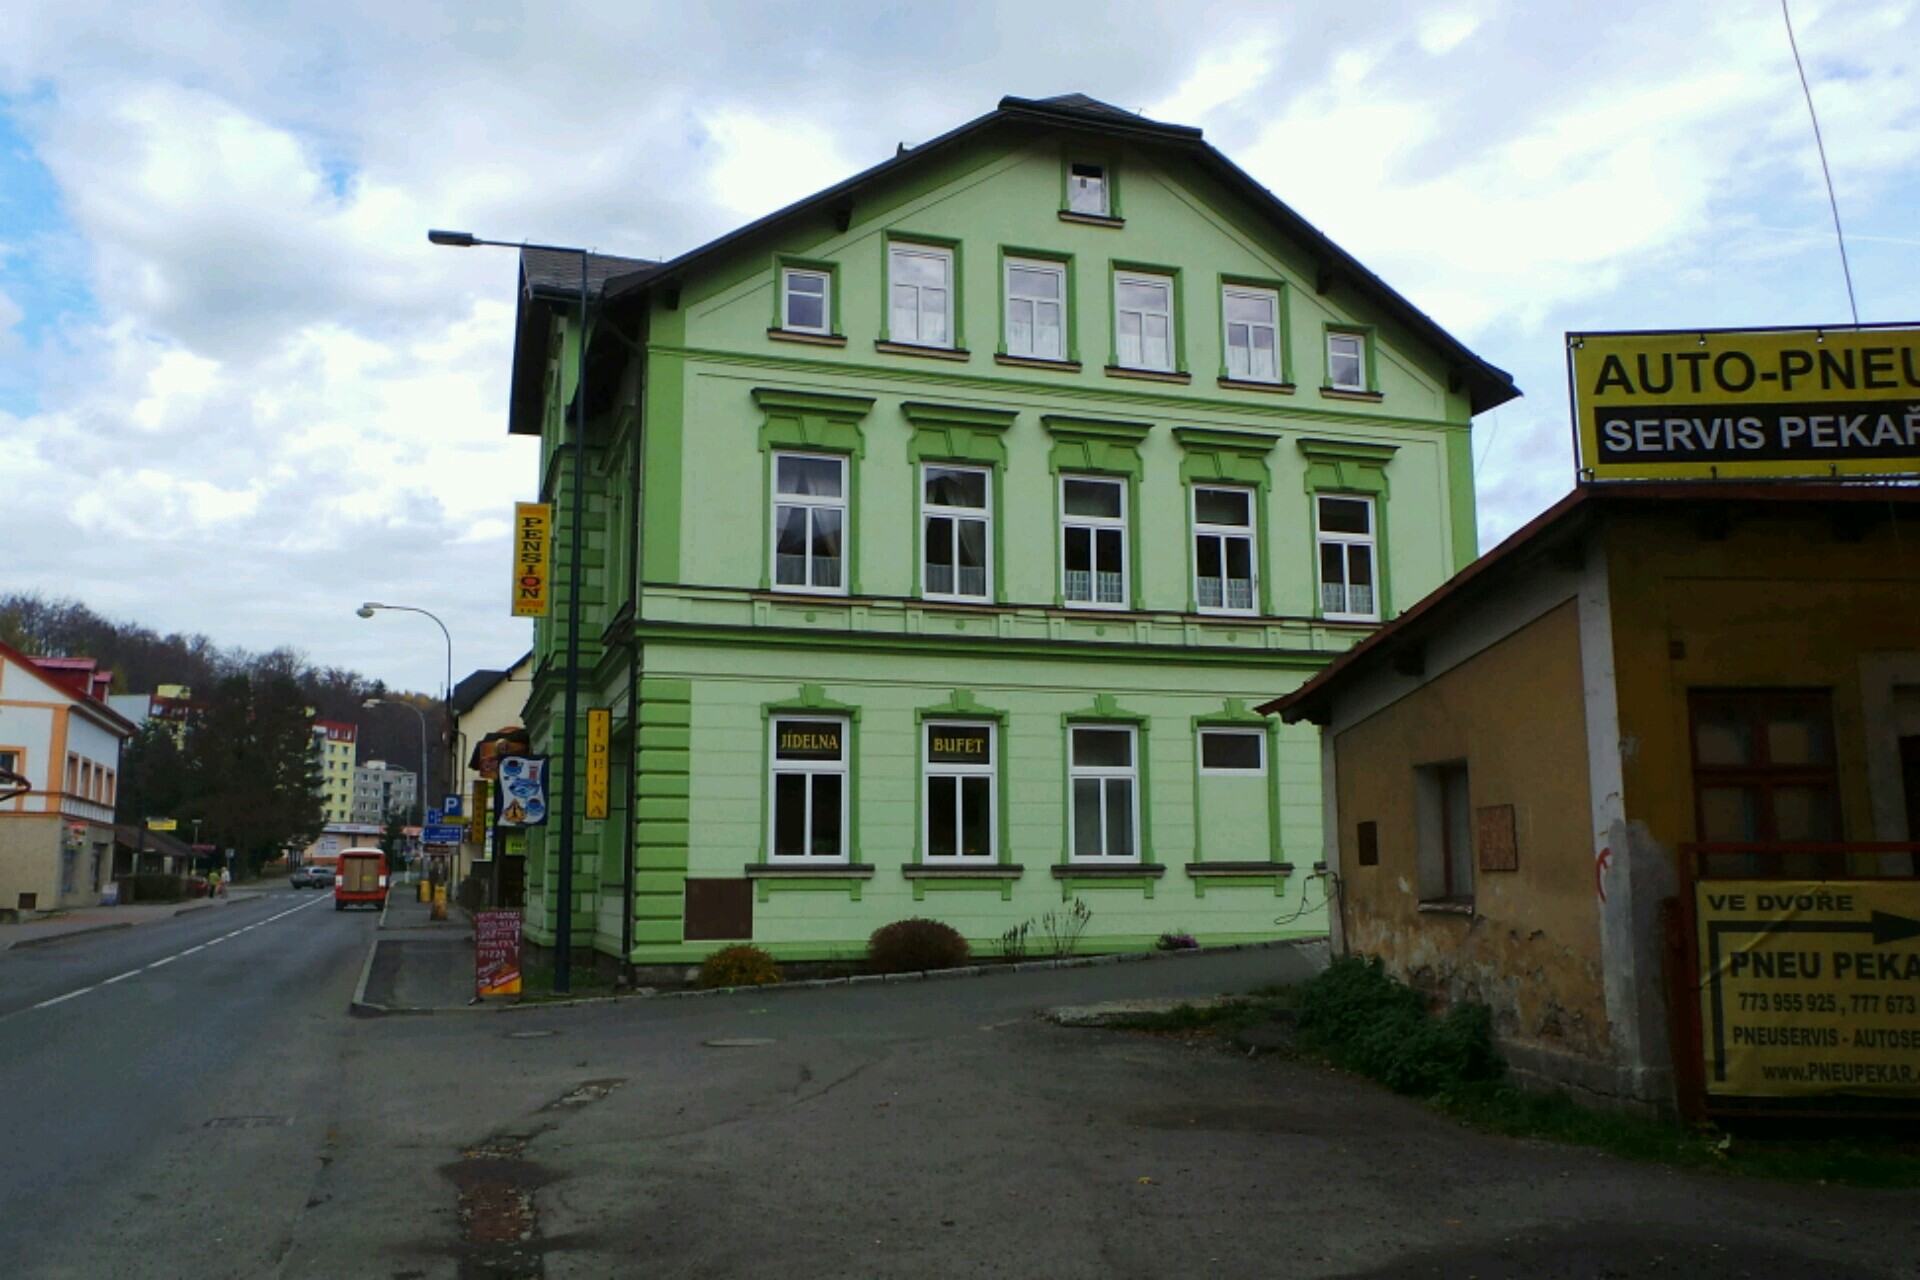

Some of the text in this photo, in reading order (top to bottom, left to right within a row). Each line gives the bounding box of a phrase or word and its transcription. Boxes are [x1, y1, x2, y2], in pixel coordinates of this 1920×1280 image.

[1604, 418, 1765, 451] SERVIS
[520, 517, 542, 599] PENSION
[781, 728, 838, 750] JÍDELNA
[933, 737, 984, 753] BUFET
[444, 797, 458, 814] P
[1707, 891, 1854, 912] VE DVOŘE
[1730, 951, 1821, 979] PNEU
[1739, 993, 1768, 1012] 773
[1773, 993, 1801, 1012] 955
[1850, 995, 1880, 1014] 777
[1887, 995, 1916, 1014] 673
[1733, 1026, 1839, 1047] PNEUSERVIS
[1763, 1061, 1920, 1083] www.PNEUPEKAR.
